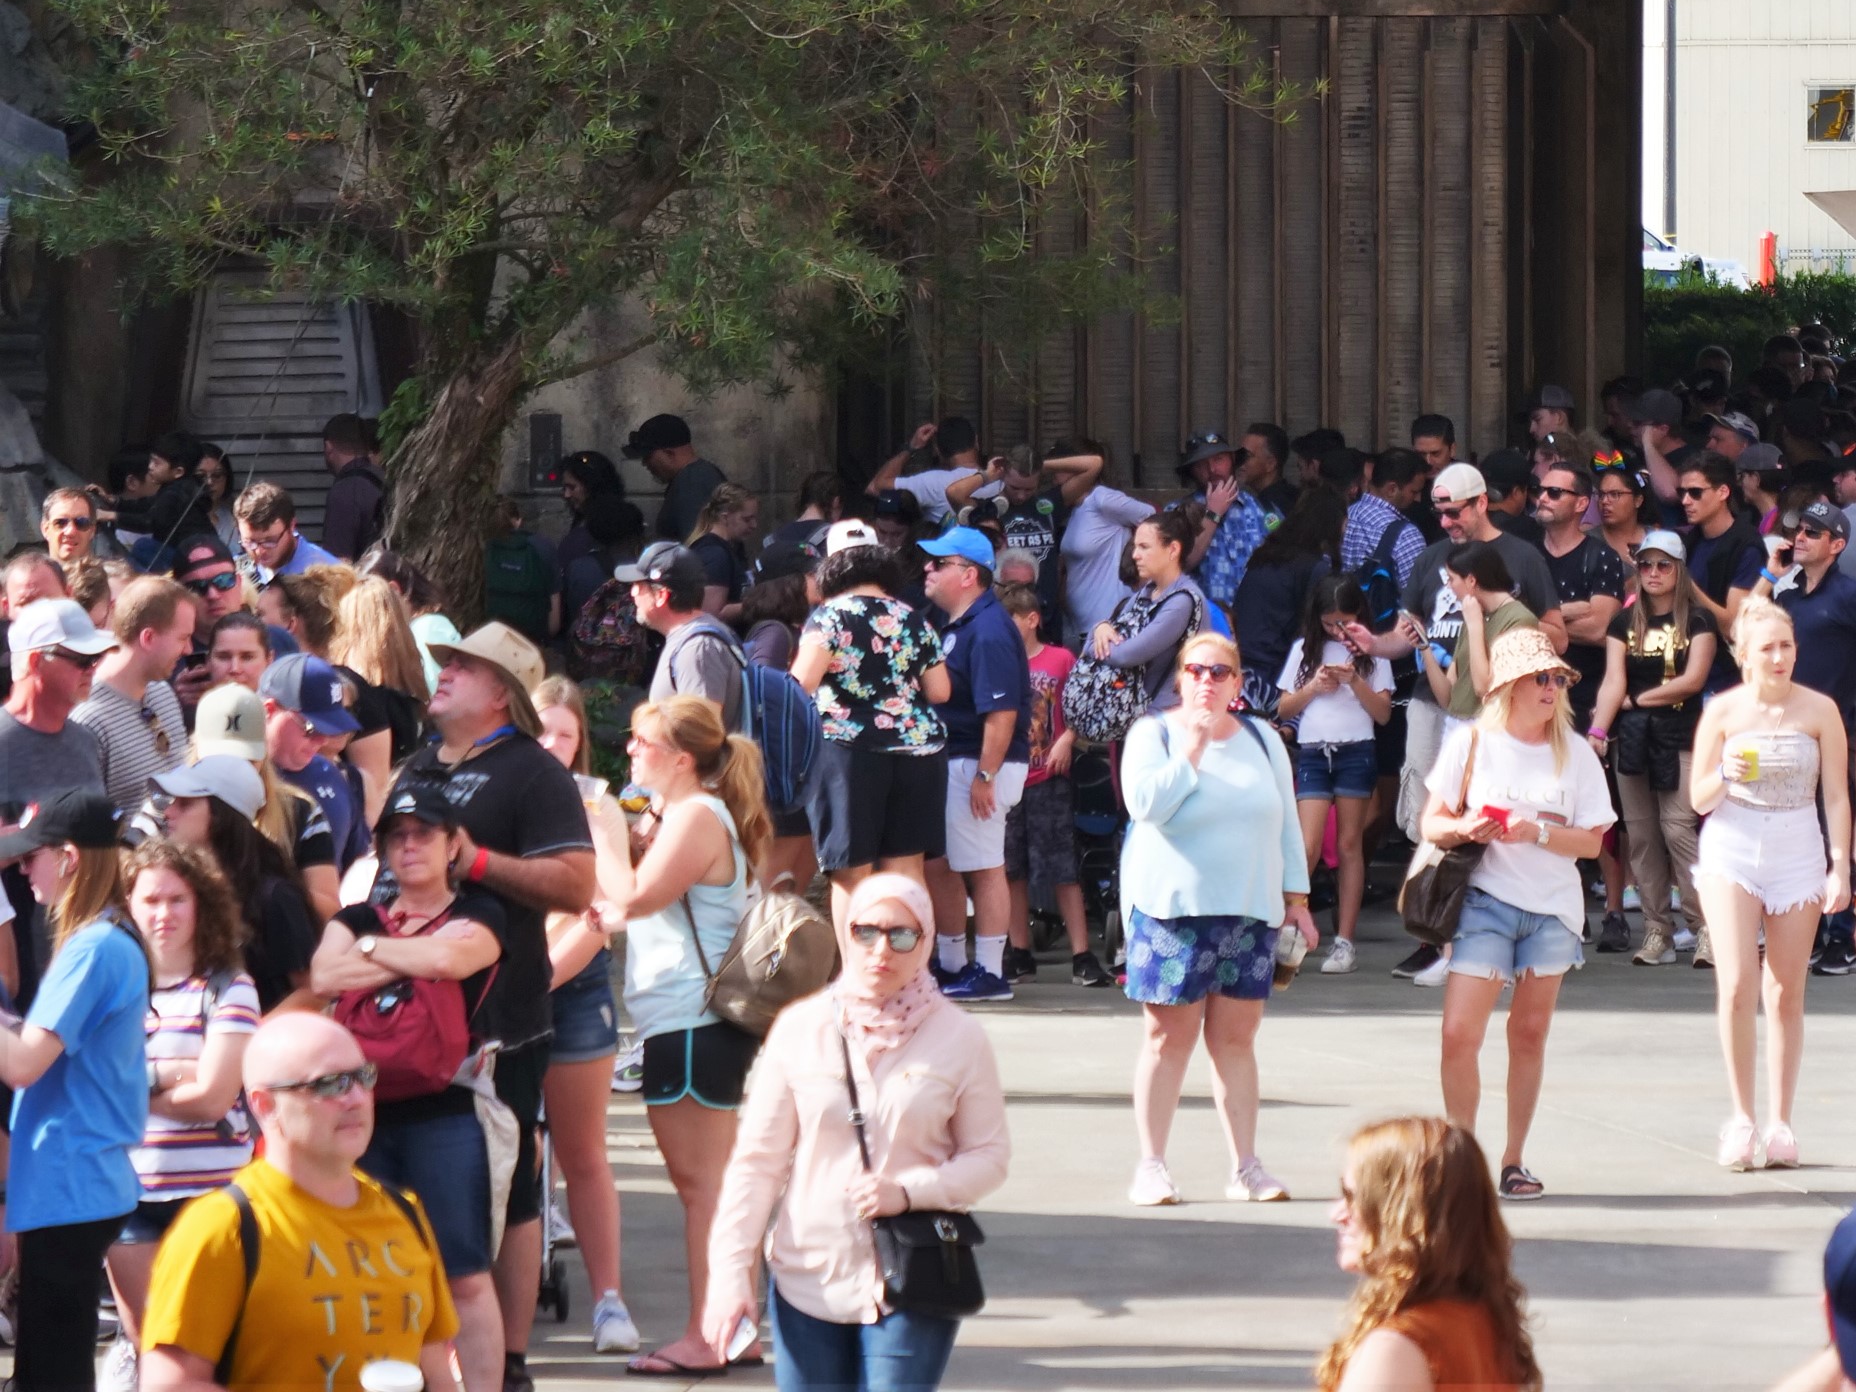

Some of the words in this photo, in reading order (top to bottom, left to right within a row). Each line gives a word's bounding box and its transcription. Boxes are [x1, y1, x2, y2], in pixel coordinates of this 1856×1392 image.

[1007, 536, 1025, 546] EET
[1028, 535, 1041, 546] AS
[1487, 784, 1565, 806] GUCCI
[304, 1238, 415, 1280] ARC
[312, 1291, 423, 1336] TER
[315, 1351, 390, 1392] Y
